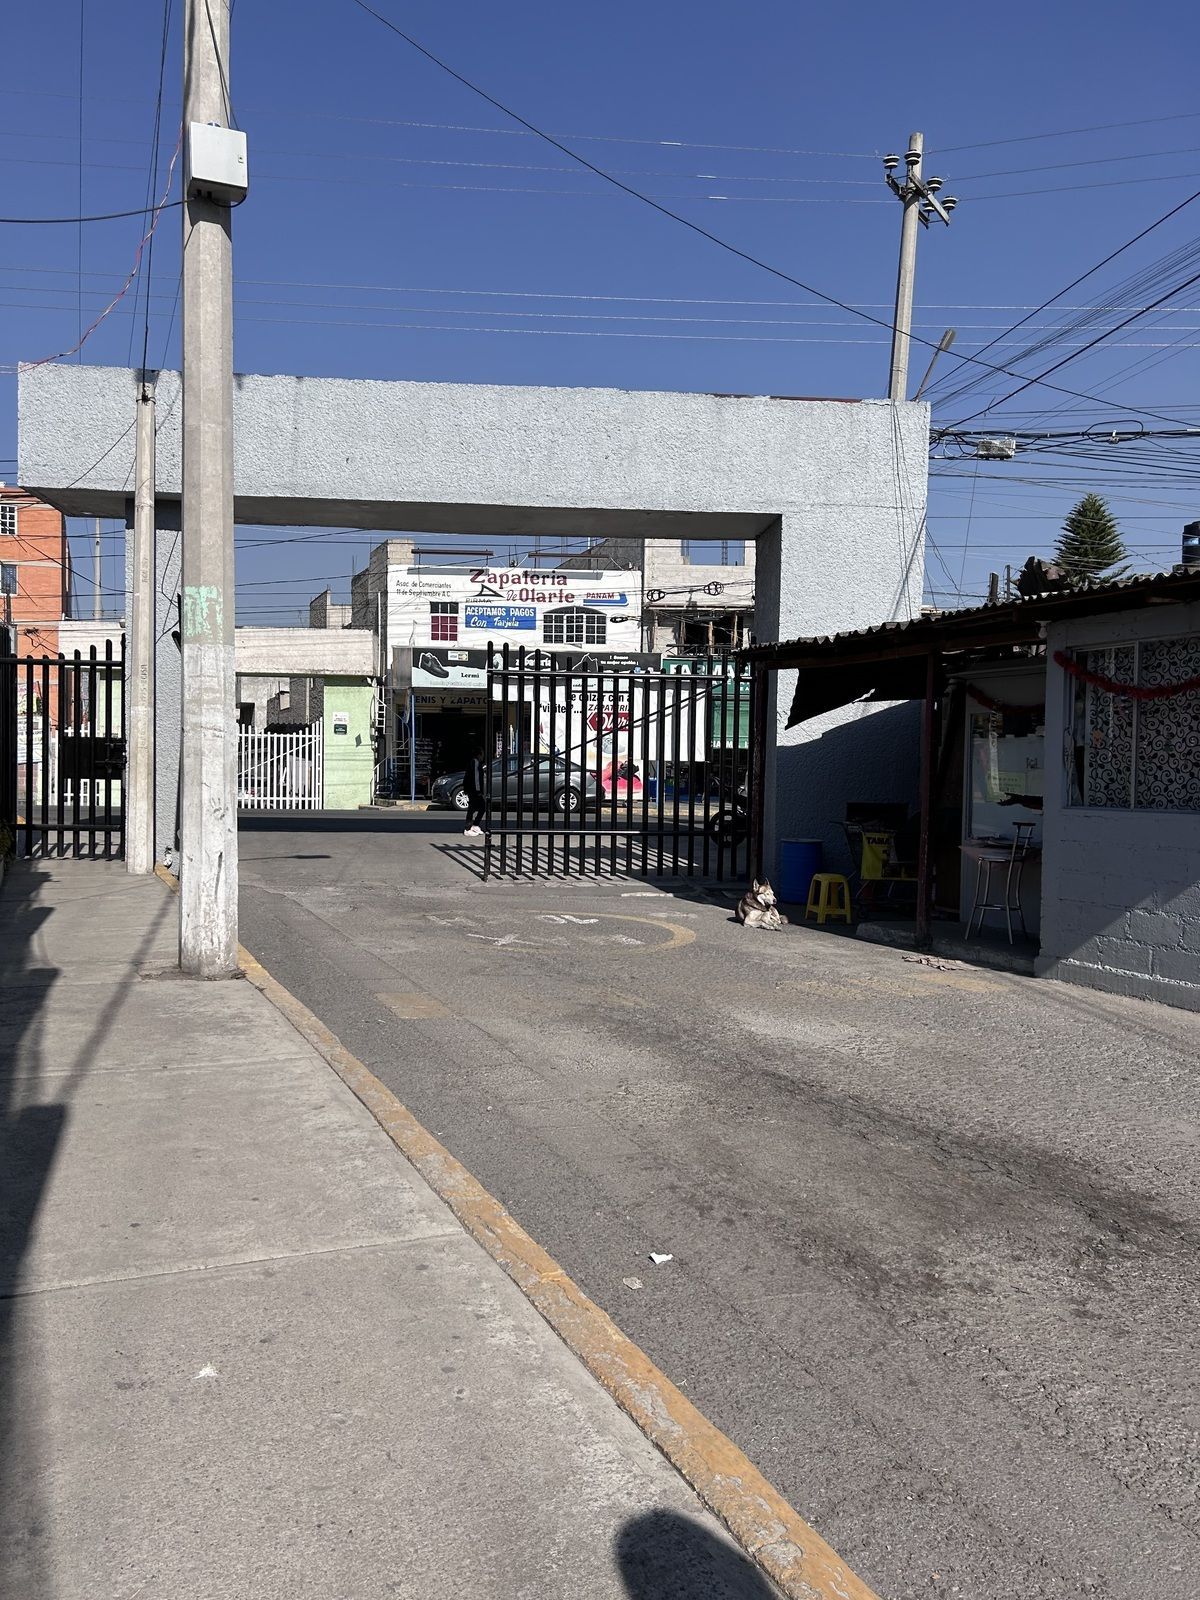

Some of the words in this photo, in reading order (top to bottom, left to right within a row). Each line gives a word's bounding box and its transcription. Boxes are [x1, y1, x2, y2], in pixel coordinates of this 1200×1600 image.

[519, 588, 575, 603] Olarte
[586, 592, 615, 600] PANAM
[465, 606, 506, 617] ACEPTAMOS
[510, 607, 535, 617] PAGOS
[470, 616, 487, 627] Con
